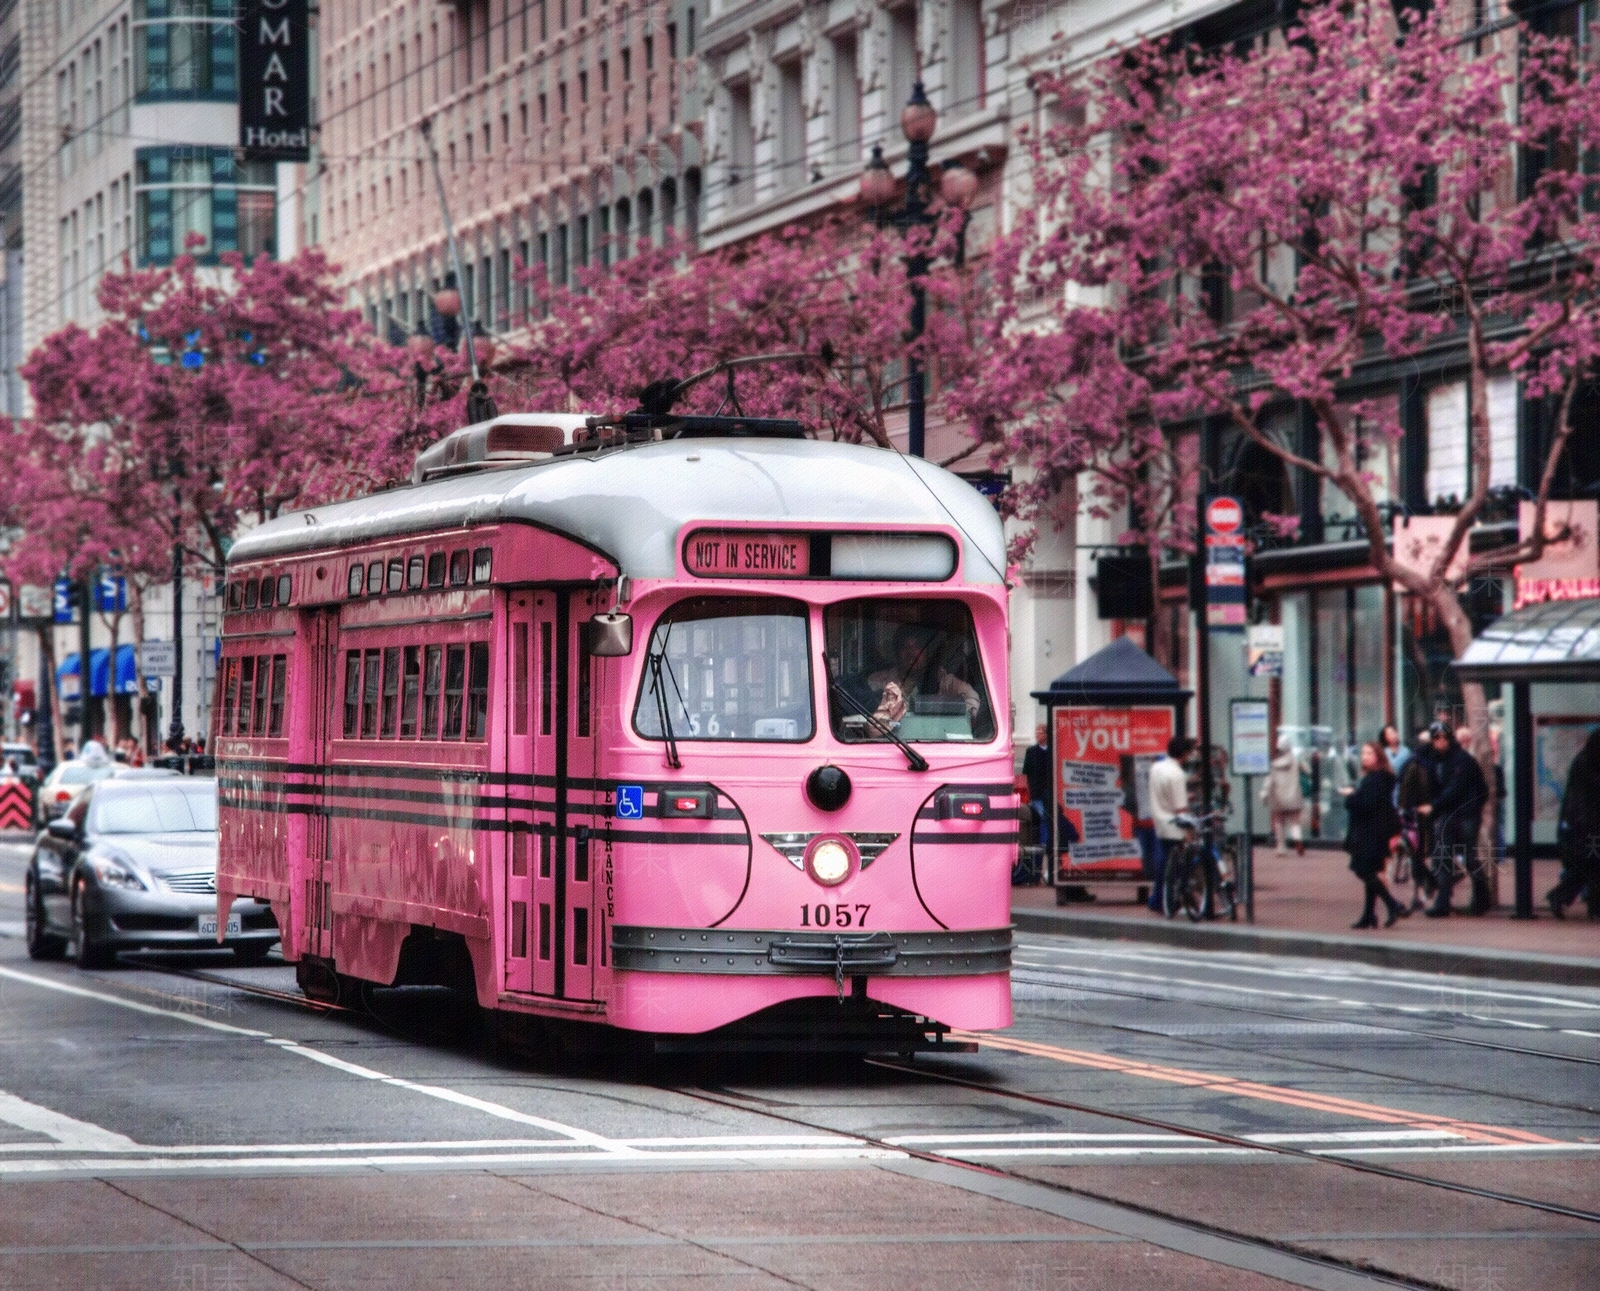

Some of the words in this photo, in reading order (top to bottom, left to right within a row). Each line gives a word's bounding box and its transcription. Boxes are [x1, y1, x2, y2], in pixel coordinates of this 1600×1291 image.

[246, 126, 308, 148] Hotel
[695, 542, 720, 568] NOT
[726, 543, 738, 568] IN
[745, 543, 797, 569] SERVICE
[1074, 728, 1130, 758] you
[800, 903, 871, 927] 1057
